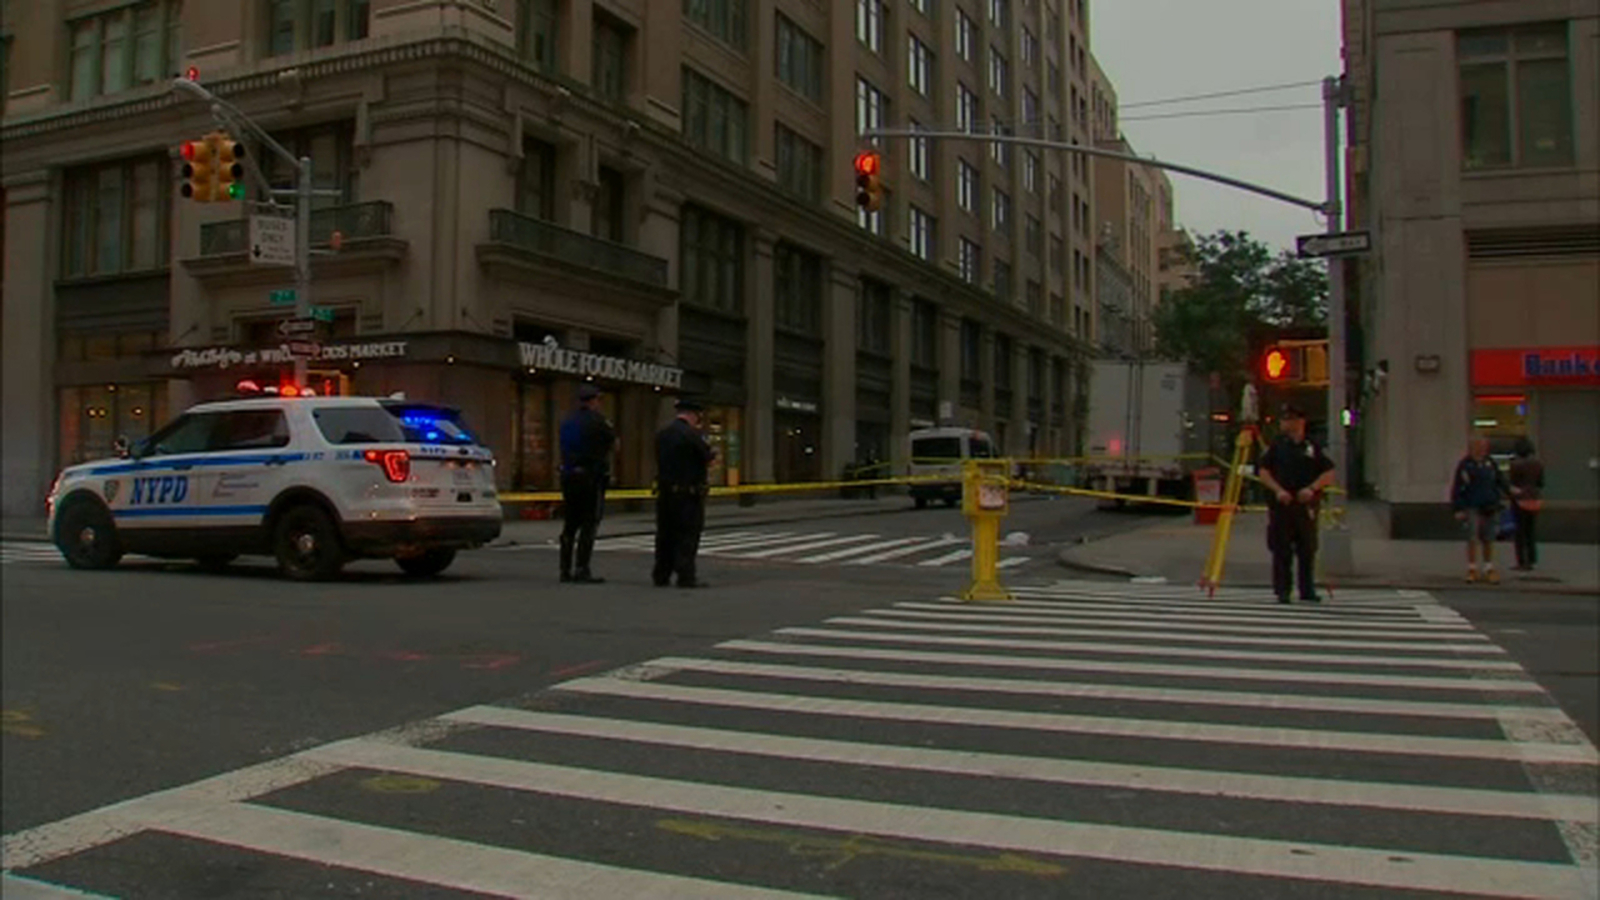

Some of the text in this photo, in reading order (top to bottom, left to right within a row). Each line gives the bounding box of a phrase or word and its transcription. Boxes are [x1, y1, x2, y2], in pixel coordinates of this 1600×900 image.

[348, 341, 407, 359] MARKET
[517, 334, 684, 388] WHOLE FOODS MARKET
[1525, 353, 1590, 376] Bank
[130, 476, 188, 504] NYPD
